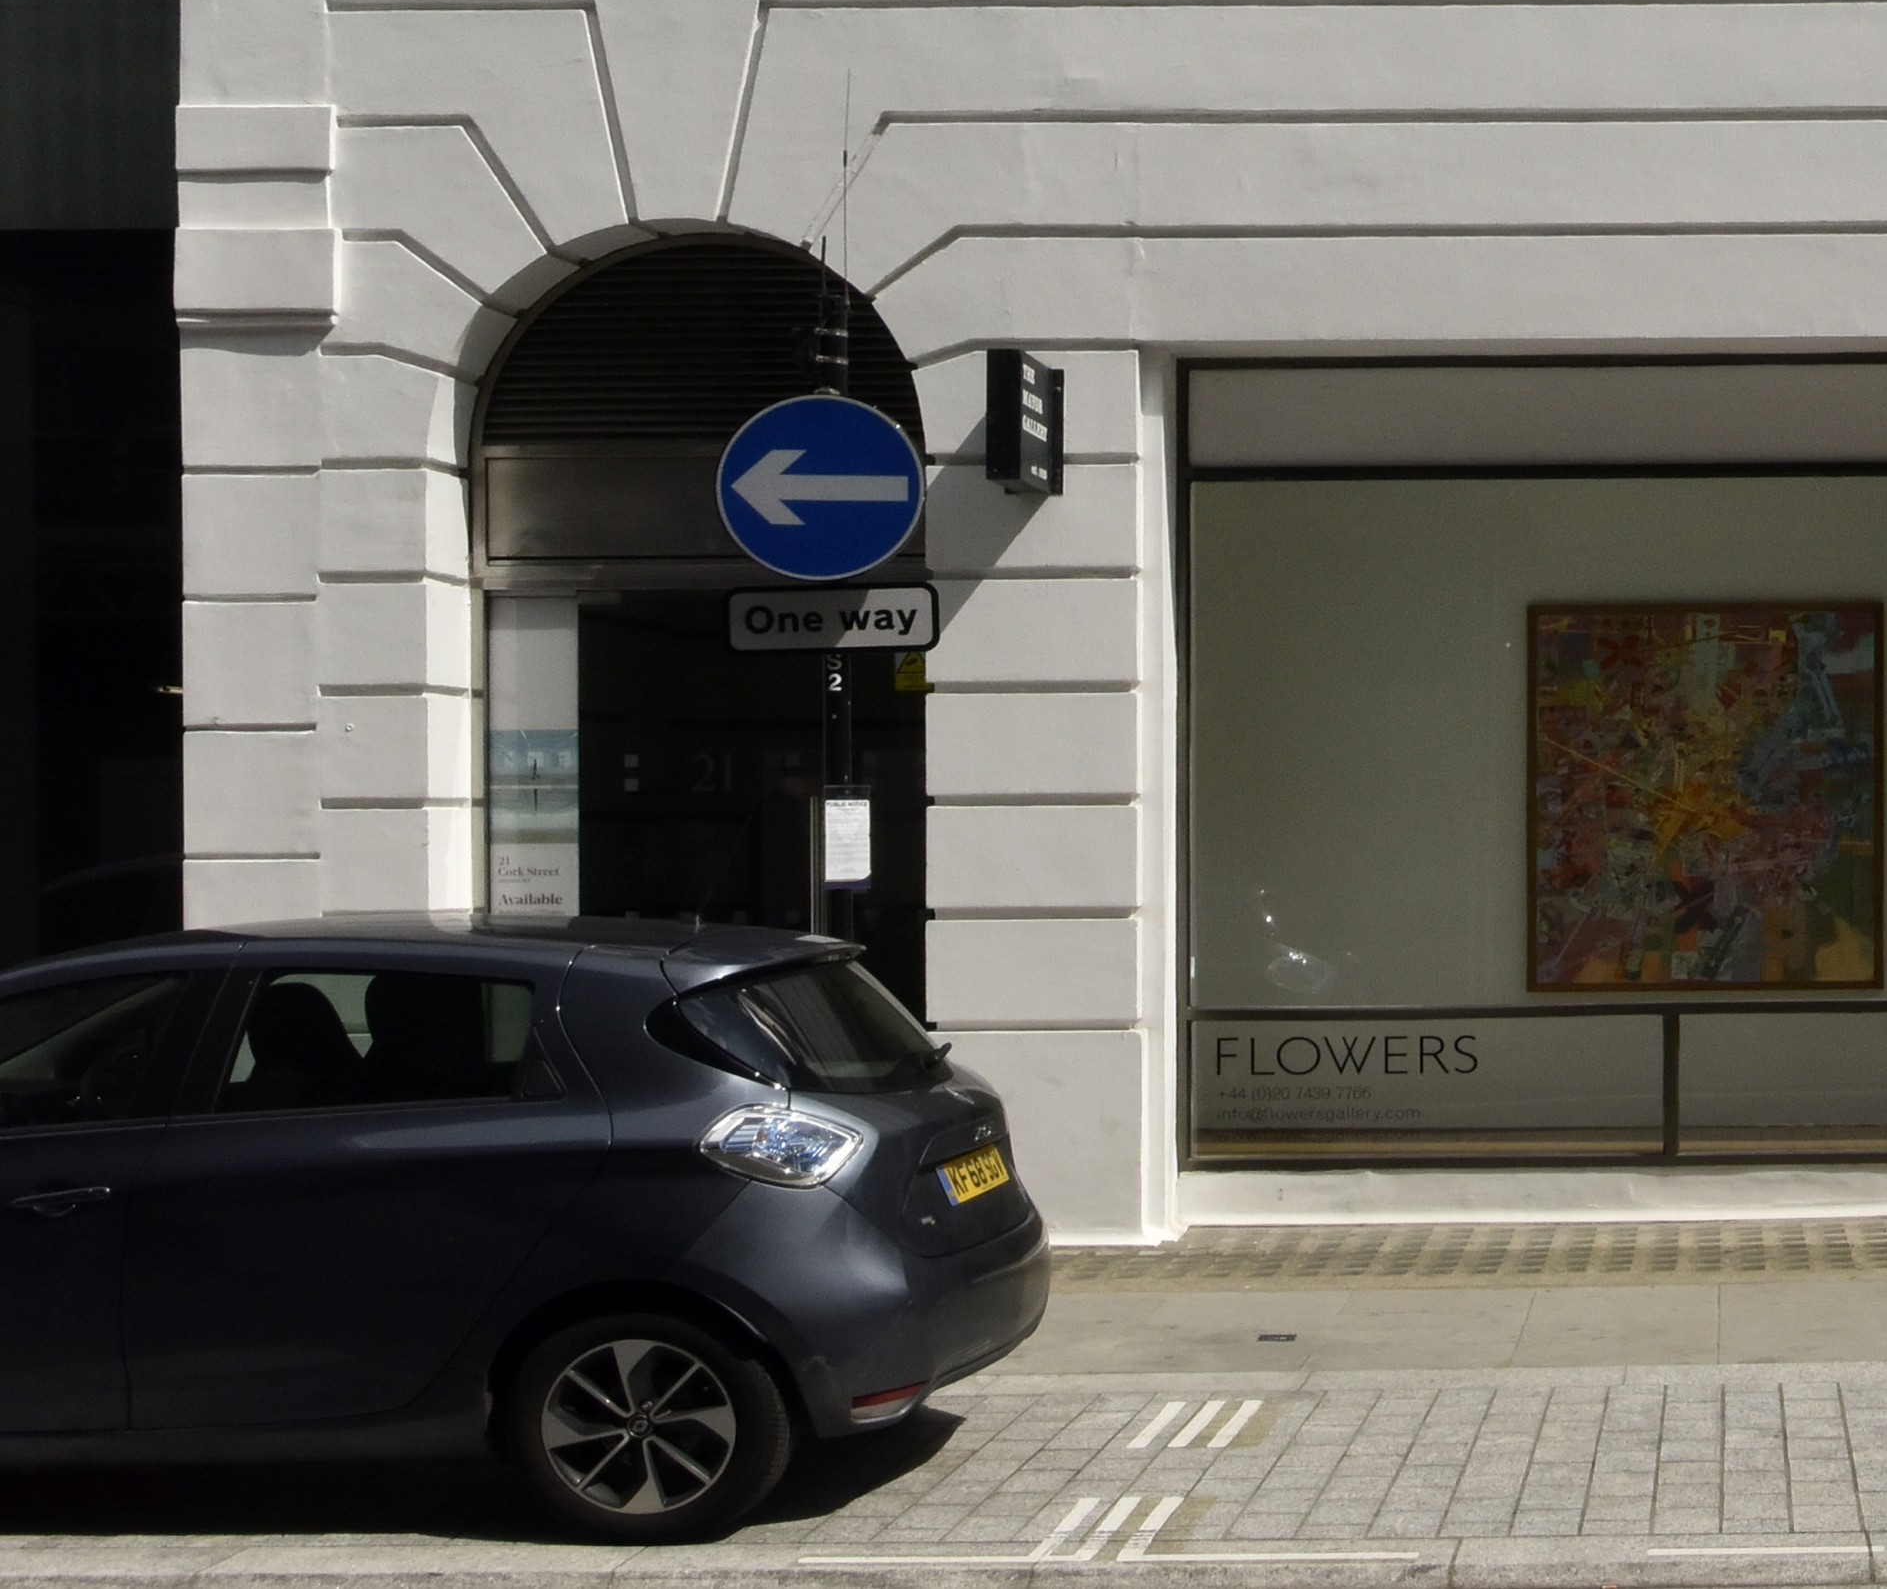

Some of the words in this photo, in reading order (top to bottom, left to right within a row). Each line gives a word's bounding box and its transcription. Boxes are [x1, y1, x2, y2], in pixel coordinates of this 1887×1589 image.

[745, 605, 824, 635] One
[839, 609, 918, 636] way
[498, 866, 525, 877] Cork
[527, 866, 560, 877] Street
[499, 892, 564, 906] Available
[1215, 1034, 1479, 1076] FLOWERS
[1218, 1086, 1247, 1100] +44
